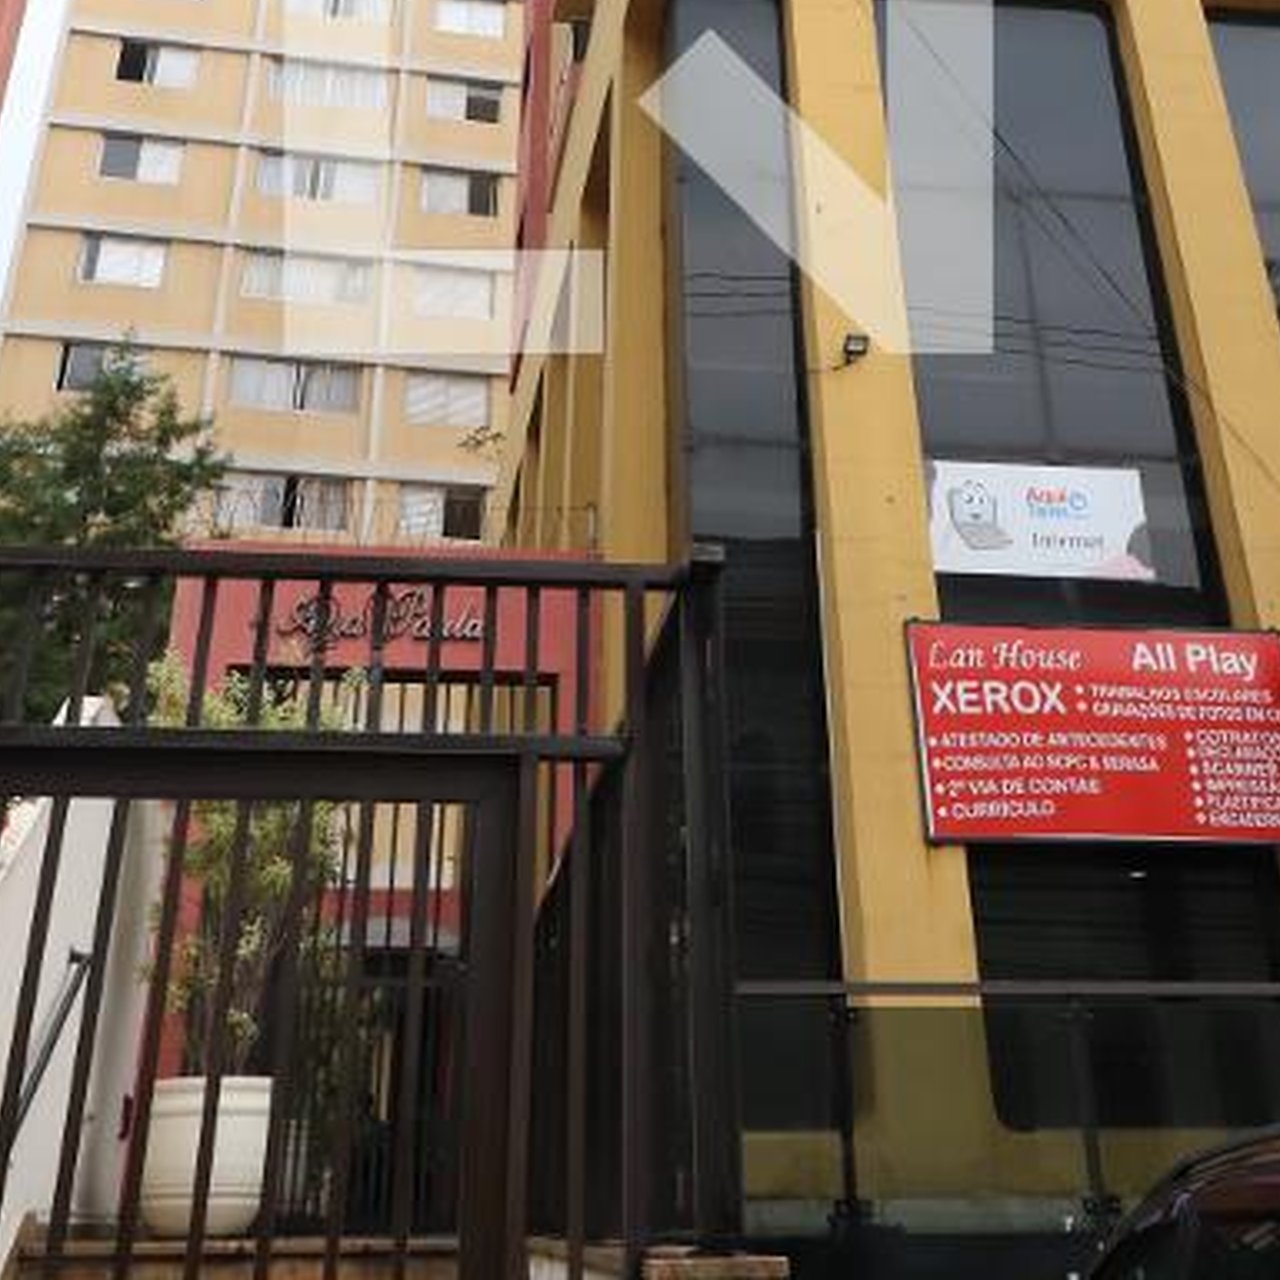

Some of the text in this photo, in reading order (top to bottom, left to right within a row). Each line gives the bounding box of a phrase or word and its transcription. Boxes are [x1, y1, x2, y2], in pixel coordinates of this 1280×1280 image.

[927, 638, 1258, 681] Lan House All Play
[930, 680, 1067, 715] XEROX
[940, 732, 1021, 748] ATESTADO
[1022, 733, 1044, 748] DE
[968, 780, 1000, 796] VIA
[1002, 779, 1026, 795] DE
[1027, 777, 1102, 795] CONTAS
